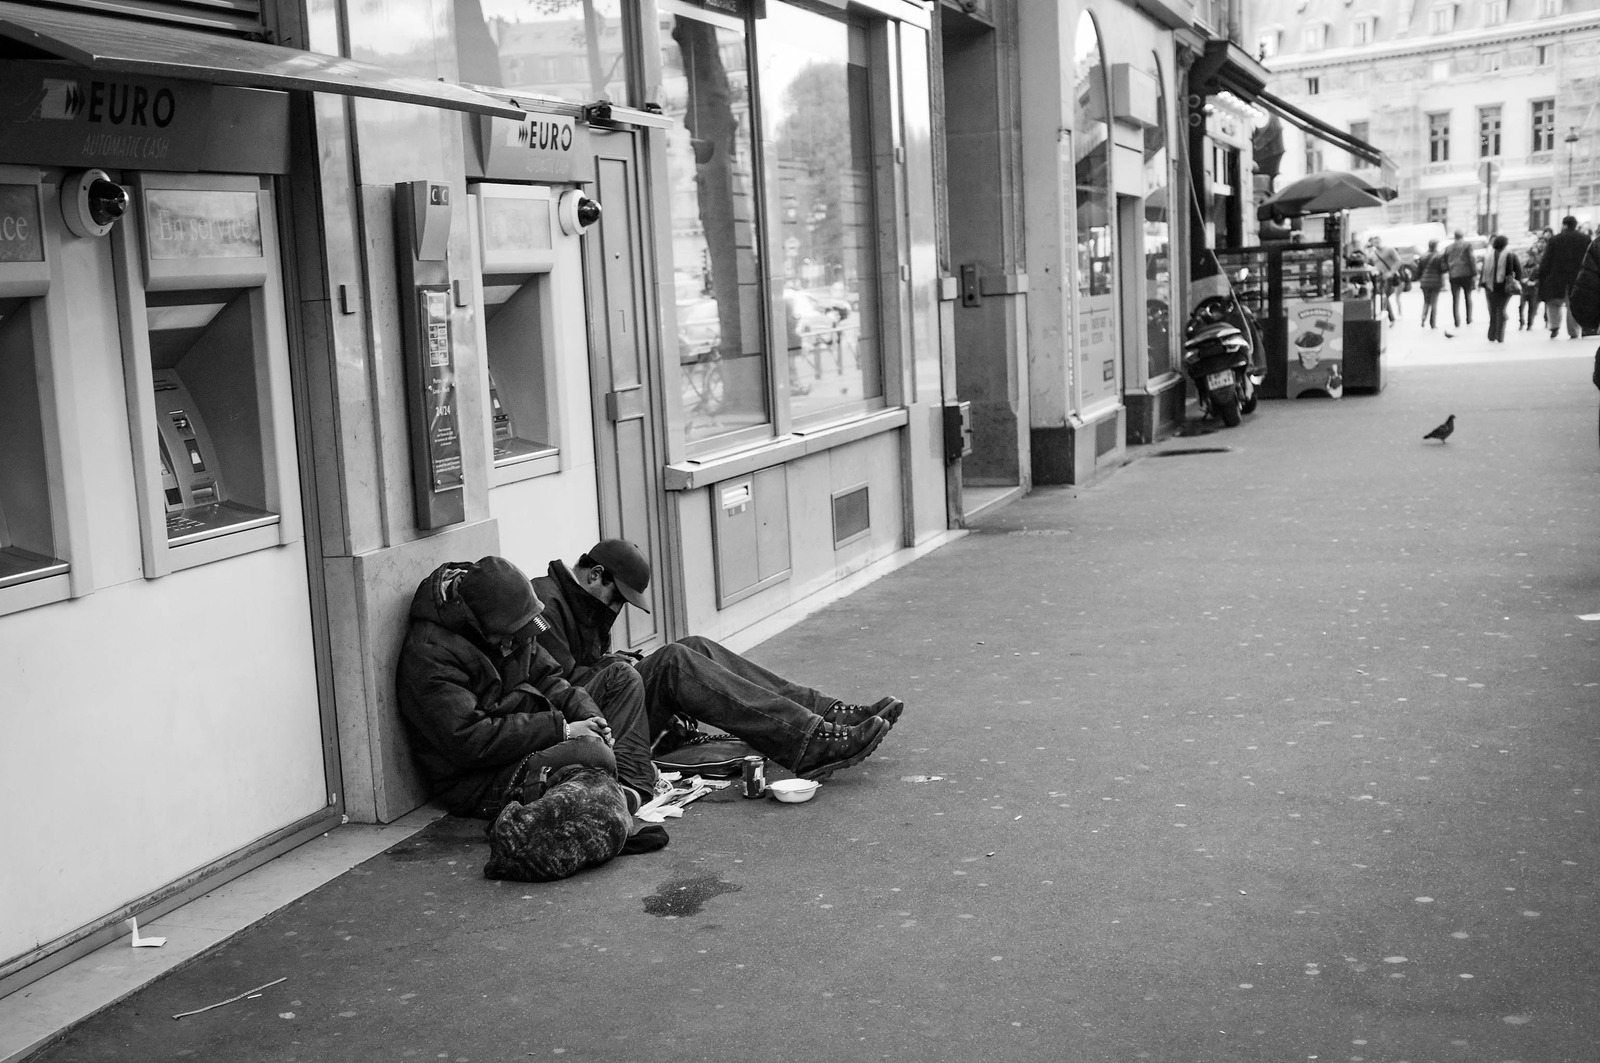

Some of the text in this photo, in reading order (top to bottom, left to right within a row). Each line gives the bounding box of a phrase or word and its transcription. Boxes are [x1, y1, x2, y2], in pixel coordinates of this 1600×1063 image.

[88, 81, 175, 128] EURO
[82, 133, 170, 159] AUTOMATIC CASH
[529, 121, 572, 151] EURO
[158, 209, 250, 241] En service
